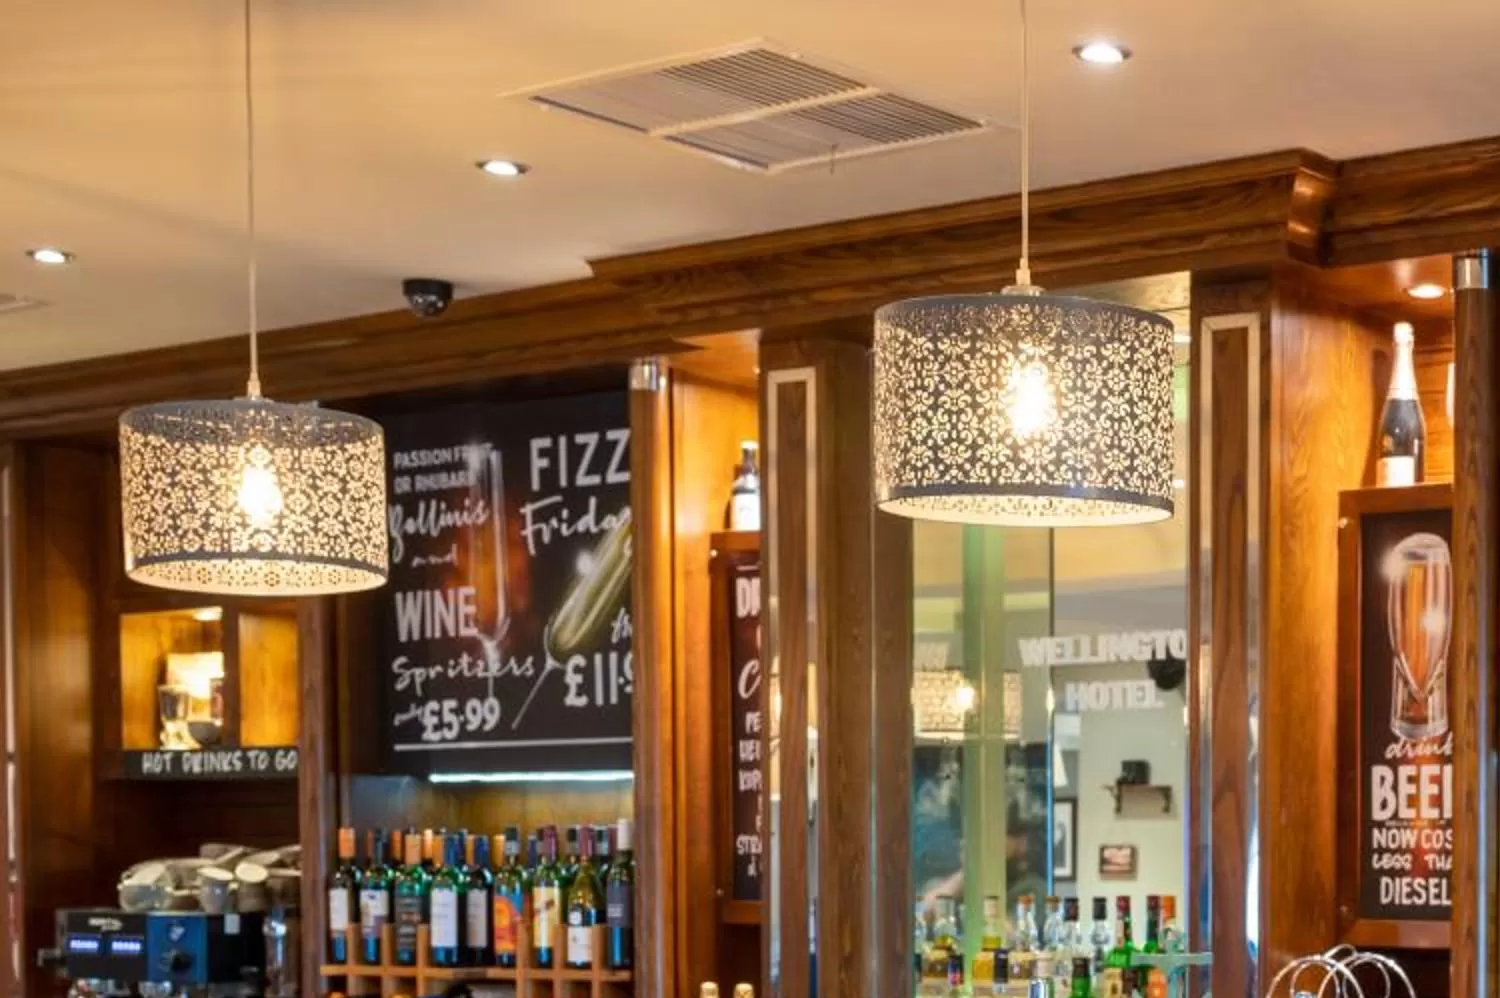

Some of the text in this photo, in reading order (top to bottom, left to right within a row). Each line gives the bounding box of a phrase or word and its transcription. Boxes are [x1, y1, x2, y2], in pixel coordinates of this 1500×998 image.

[529, 428, 631, 492] FIZZ
[395, 586, 478, 643] WINE
[141, 748, 298, 775] HOT DRINKS TO GO
[1372, 827, 1417, 850] NOW
[1379, 876, 1453, 906] DIESEL
